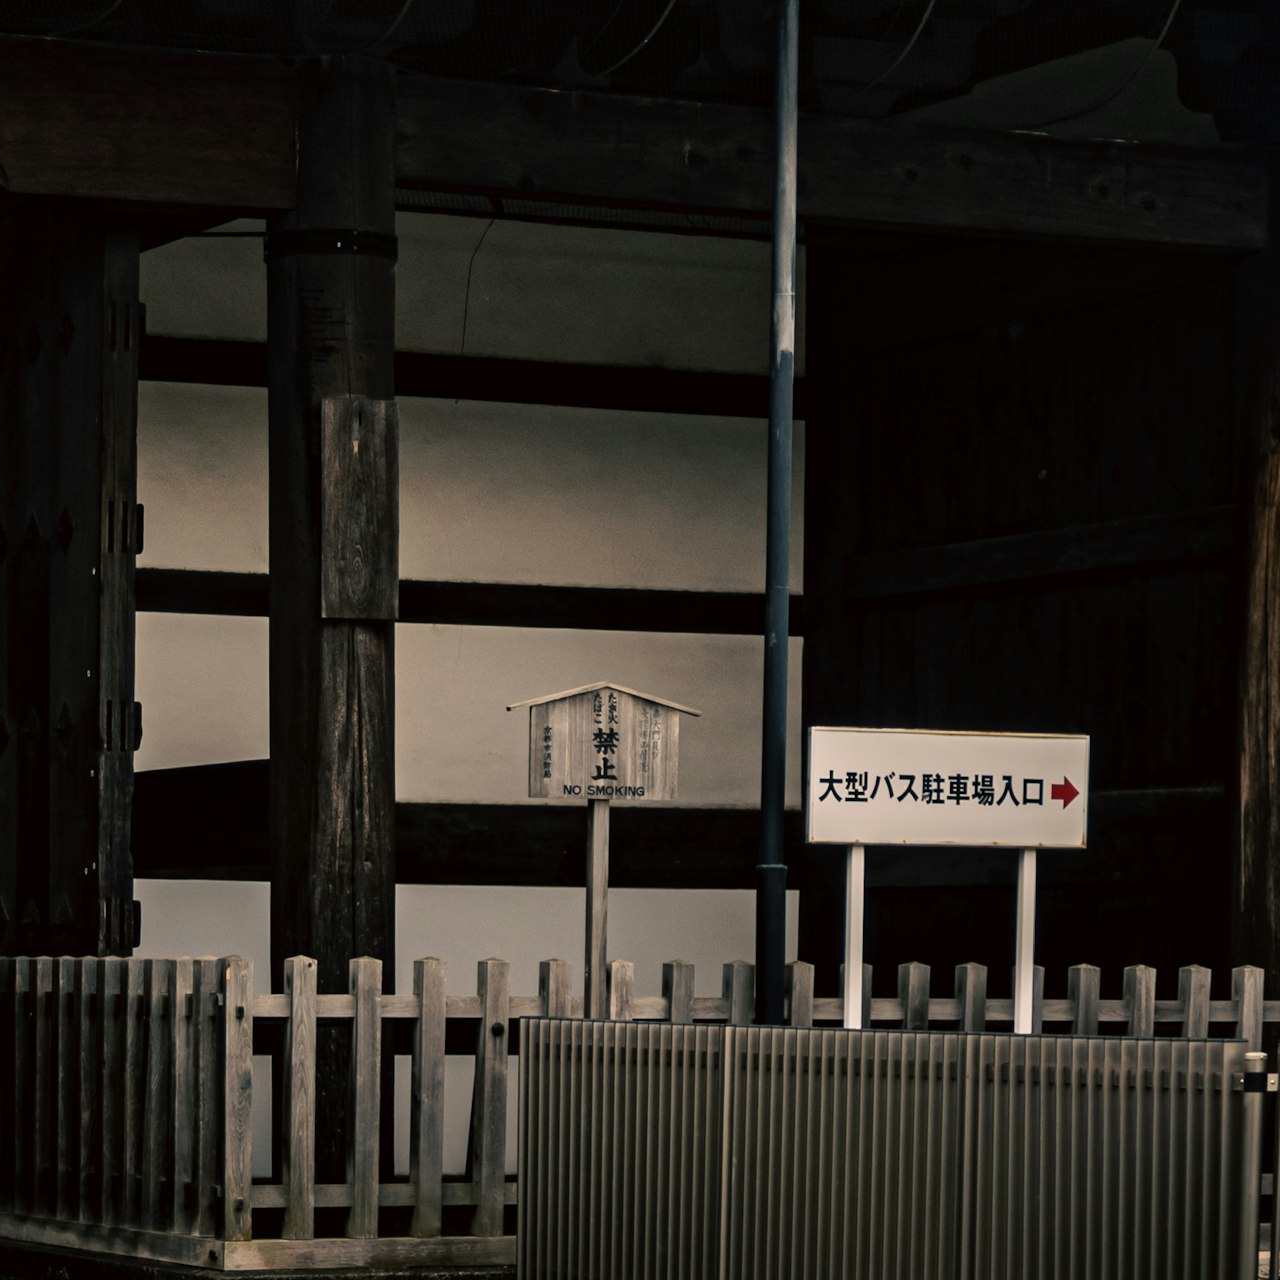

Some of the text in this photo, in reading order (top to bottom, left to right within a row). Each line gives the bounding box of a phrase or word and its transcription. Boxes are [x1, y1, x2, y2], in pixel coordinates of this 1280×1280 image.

[593, 691, 603, 724] たばこ
[591, 727, 620, 781] 禁止
[563, 784, 645, 797] NO SMOKING
[818, 769, 1044, 807] 大型バス駐車場入口
